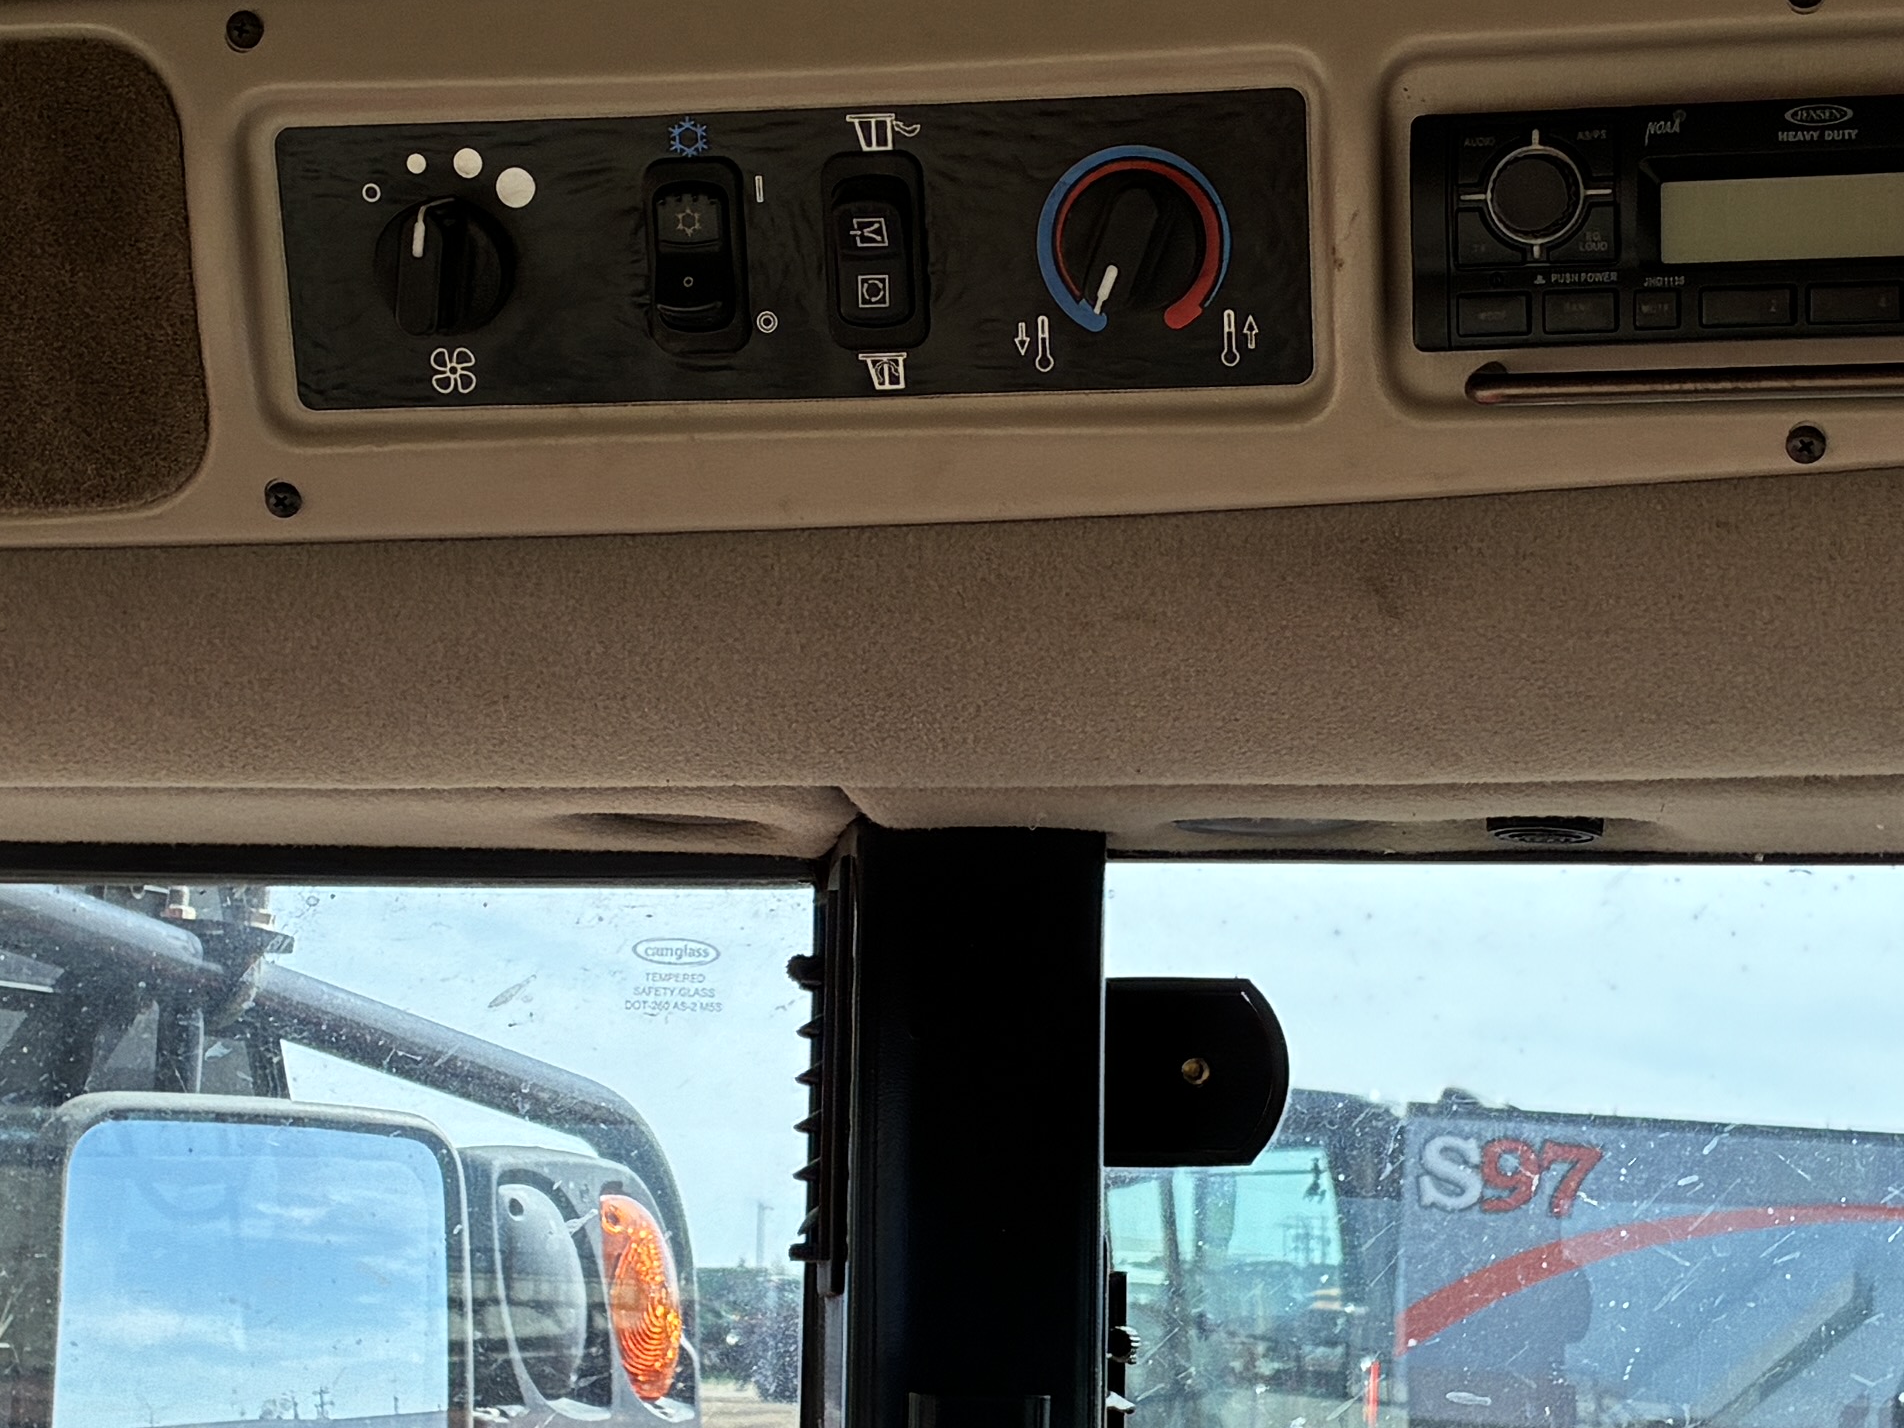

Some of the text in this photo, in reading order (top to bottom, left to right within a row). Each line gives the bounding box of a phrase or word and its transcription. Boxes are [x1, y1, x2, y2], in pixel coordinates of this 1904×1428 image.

[1794, 108, 1844, 121] JENSEN
[1778, 129, 1858, 142] HEAVY DUTY
[1464, 136, 1496, 148] AUDIO
[1579, 241, 1608, 253] LOUD
[1551, 271, 1618, 285] PUSH POWER
[645, 972, 706, 984] TEMPERED
[633, 986, 716, 998] SAFETY GLASS
[1417, 1135, 1604, 1219] S97
